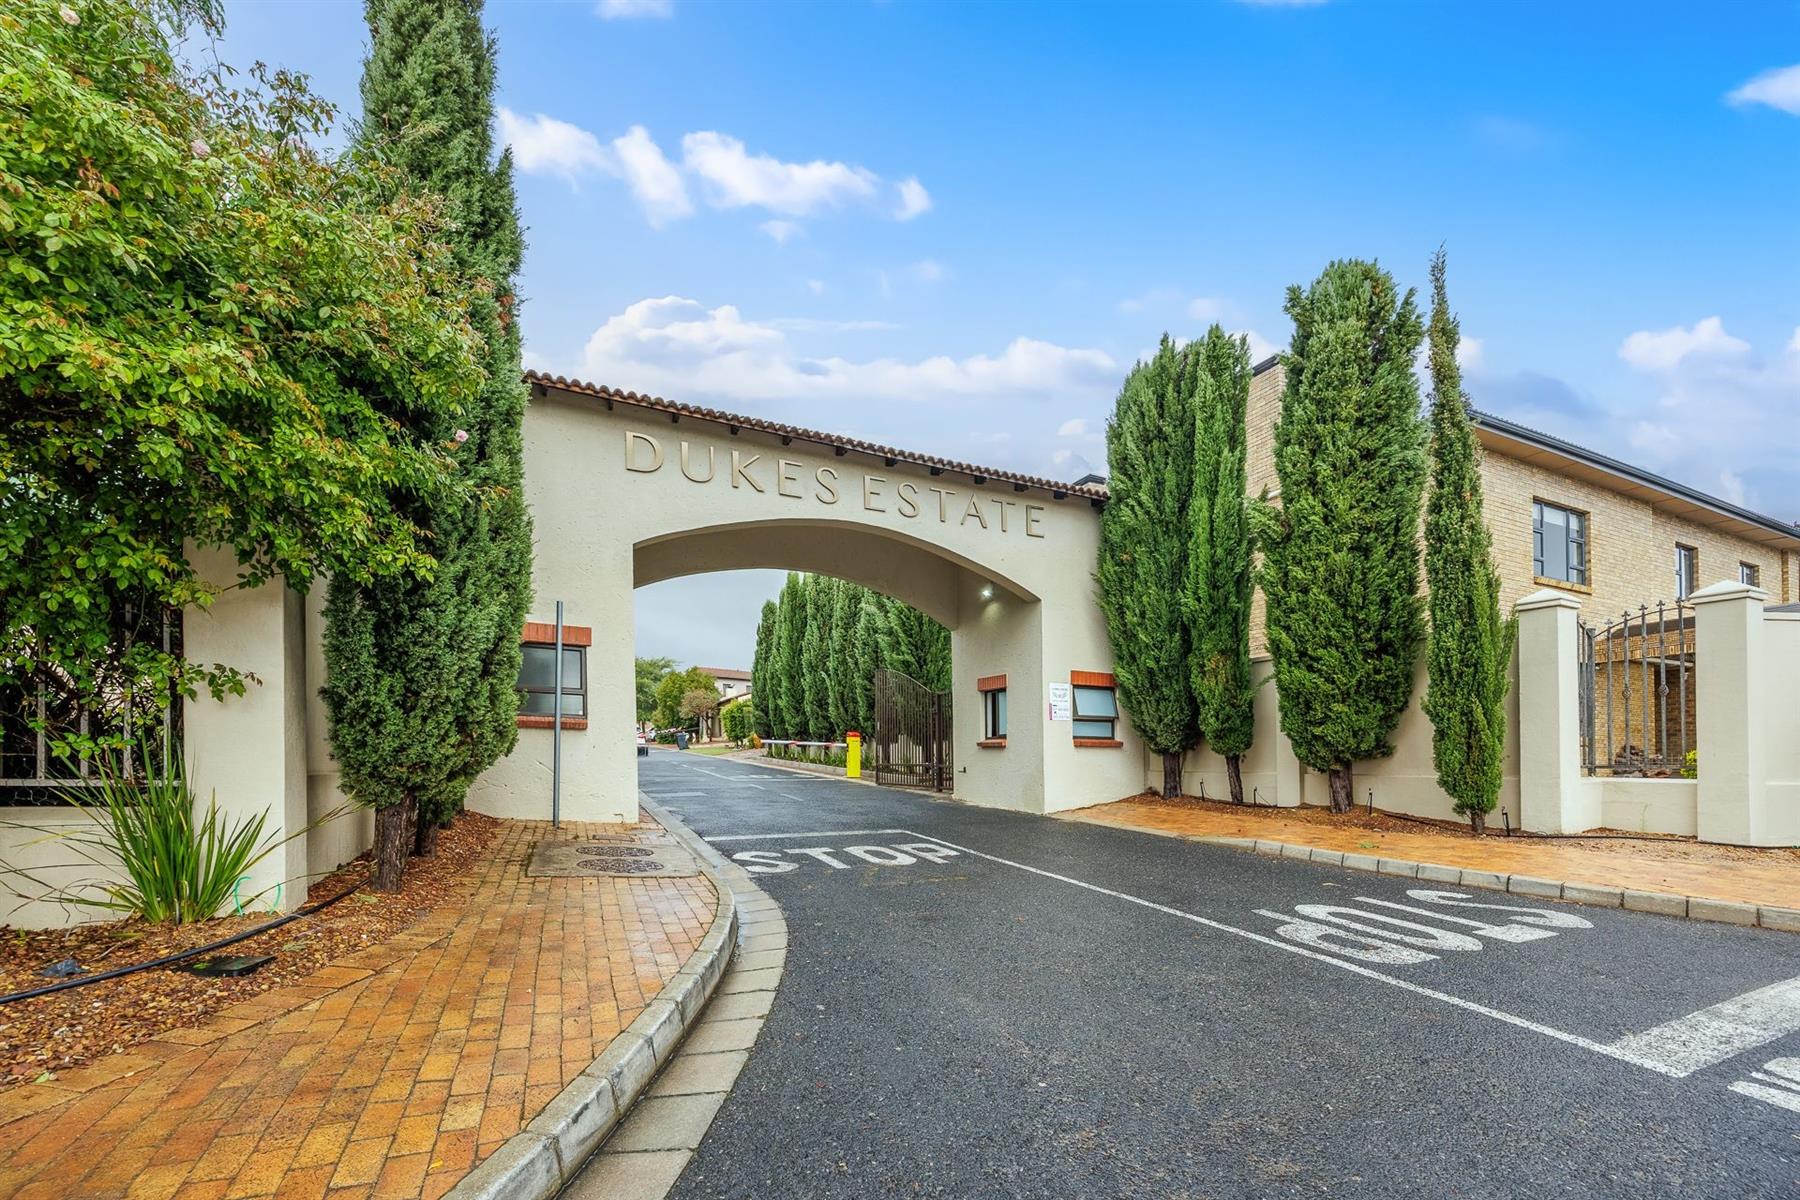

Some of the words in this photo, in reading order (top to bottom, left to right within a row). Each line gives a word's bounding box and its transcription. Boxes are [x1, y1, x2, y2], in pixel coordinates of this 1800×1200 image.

[624, 431, 840, 505] DUKES
[863, 474, 1046, 539] ESTATE
[732, 843, 960, 874] STOP
[1252, 889, 1594, 965] STOP
